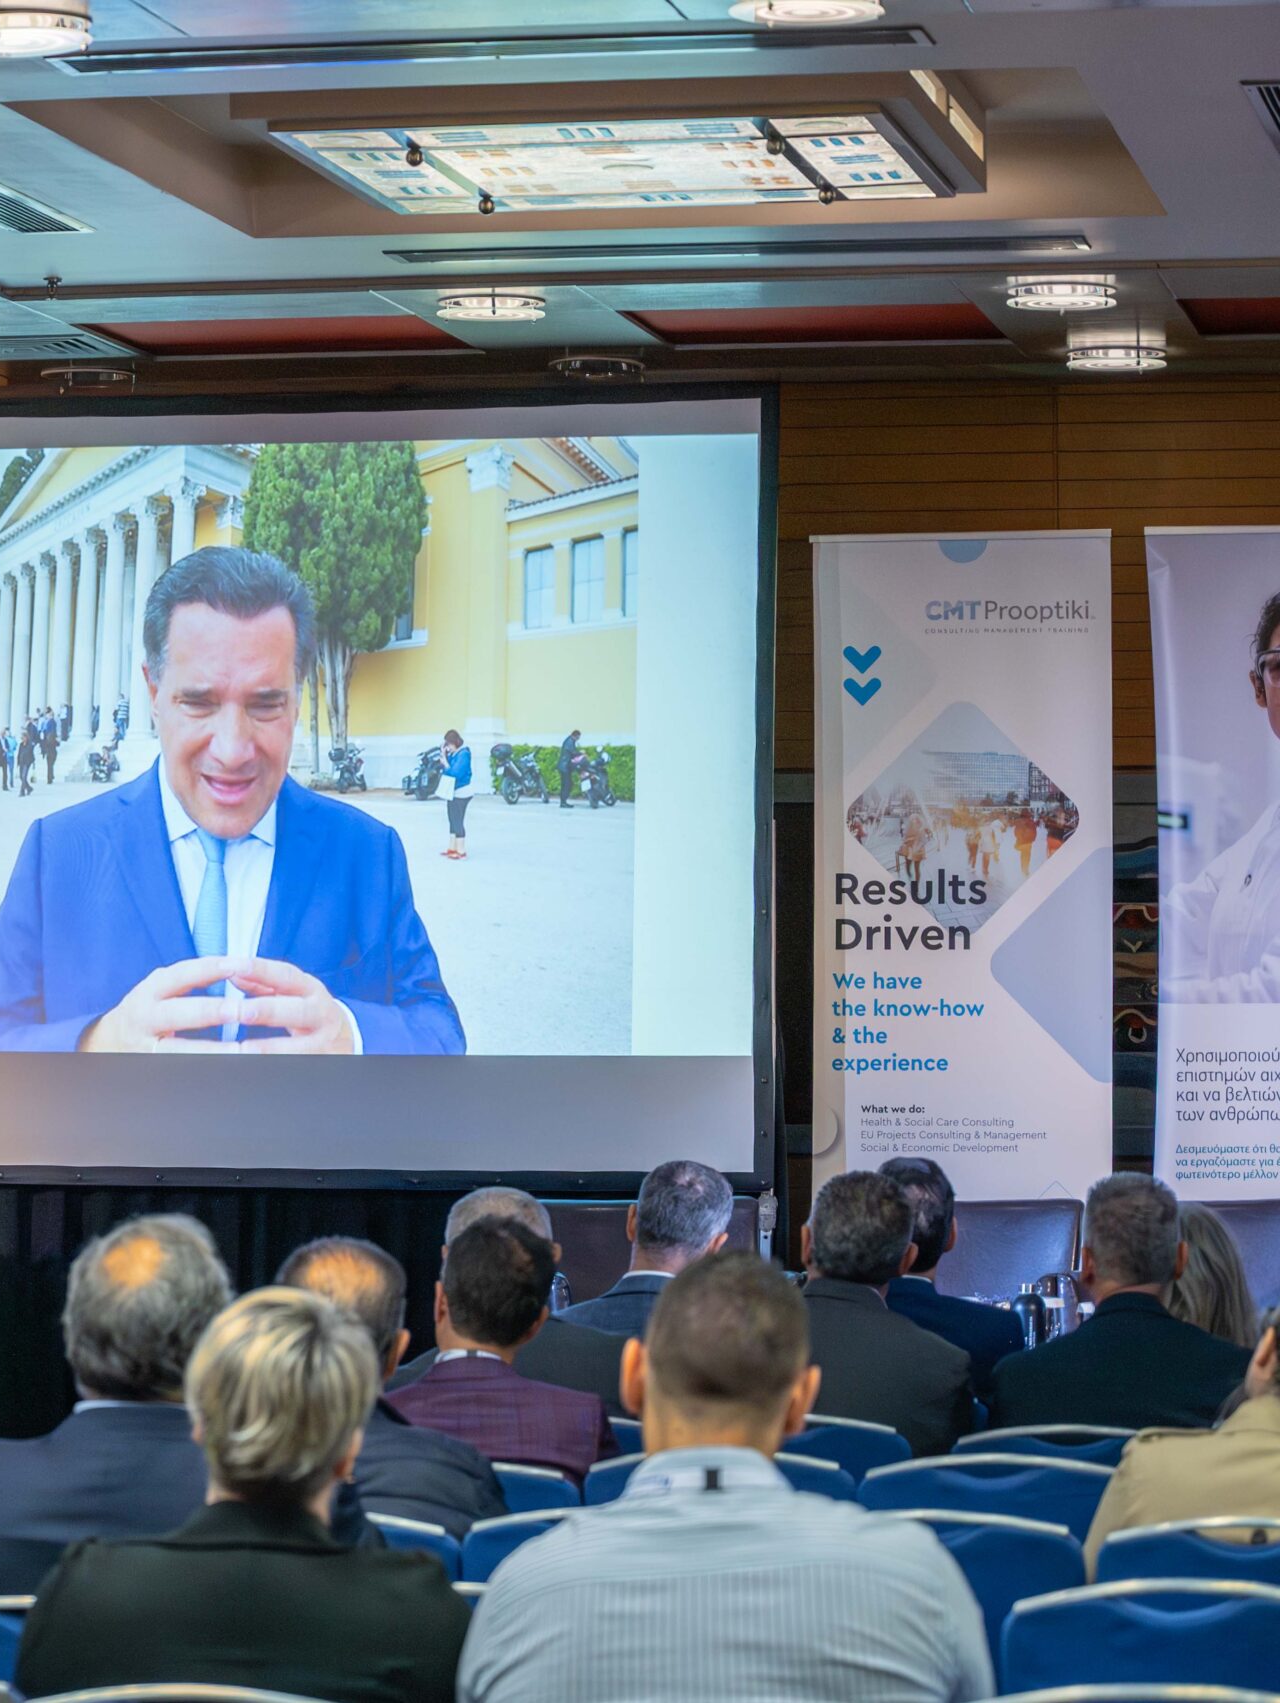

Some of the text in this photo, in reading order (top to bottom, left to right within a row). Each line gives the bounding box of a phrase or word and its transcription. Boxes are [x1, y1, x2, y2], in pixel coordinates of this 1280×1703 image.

[835, 868, 988, 905] Results
[835, 913, 971, 951] Driven
[832, 971, 922, 989] We have
[832, 998, 984, 1016] the know-how
[832, 1025, 888, 1044] & the
[1176, 1046, 1280, 1066] Χρησιμοποιού
[831, 1052, 949, 1074] experience
[1176, 1067, 1256, 1085] επιστημών
[1176, 1090, 1199, 1102] και
[1203, 1090, 1221, 1102] να
[861, 1104, 926, 1114] What we do:
[1175, 1110, 1205, 1122] των
[860, 1117, 1015, 1129] Health & Social Care Consulting
[860, 1130, 1048, 1142] EU Projects Consulting & Management
[860, 1143, 1019, 1155] Social & Economic Development
[1252, 1144, 1267, 1154] ότι
[1175, 1158, 1188, 1167] να
[1175, 1169, 1279, 1181] φωτεινότερο μέλλον
